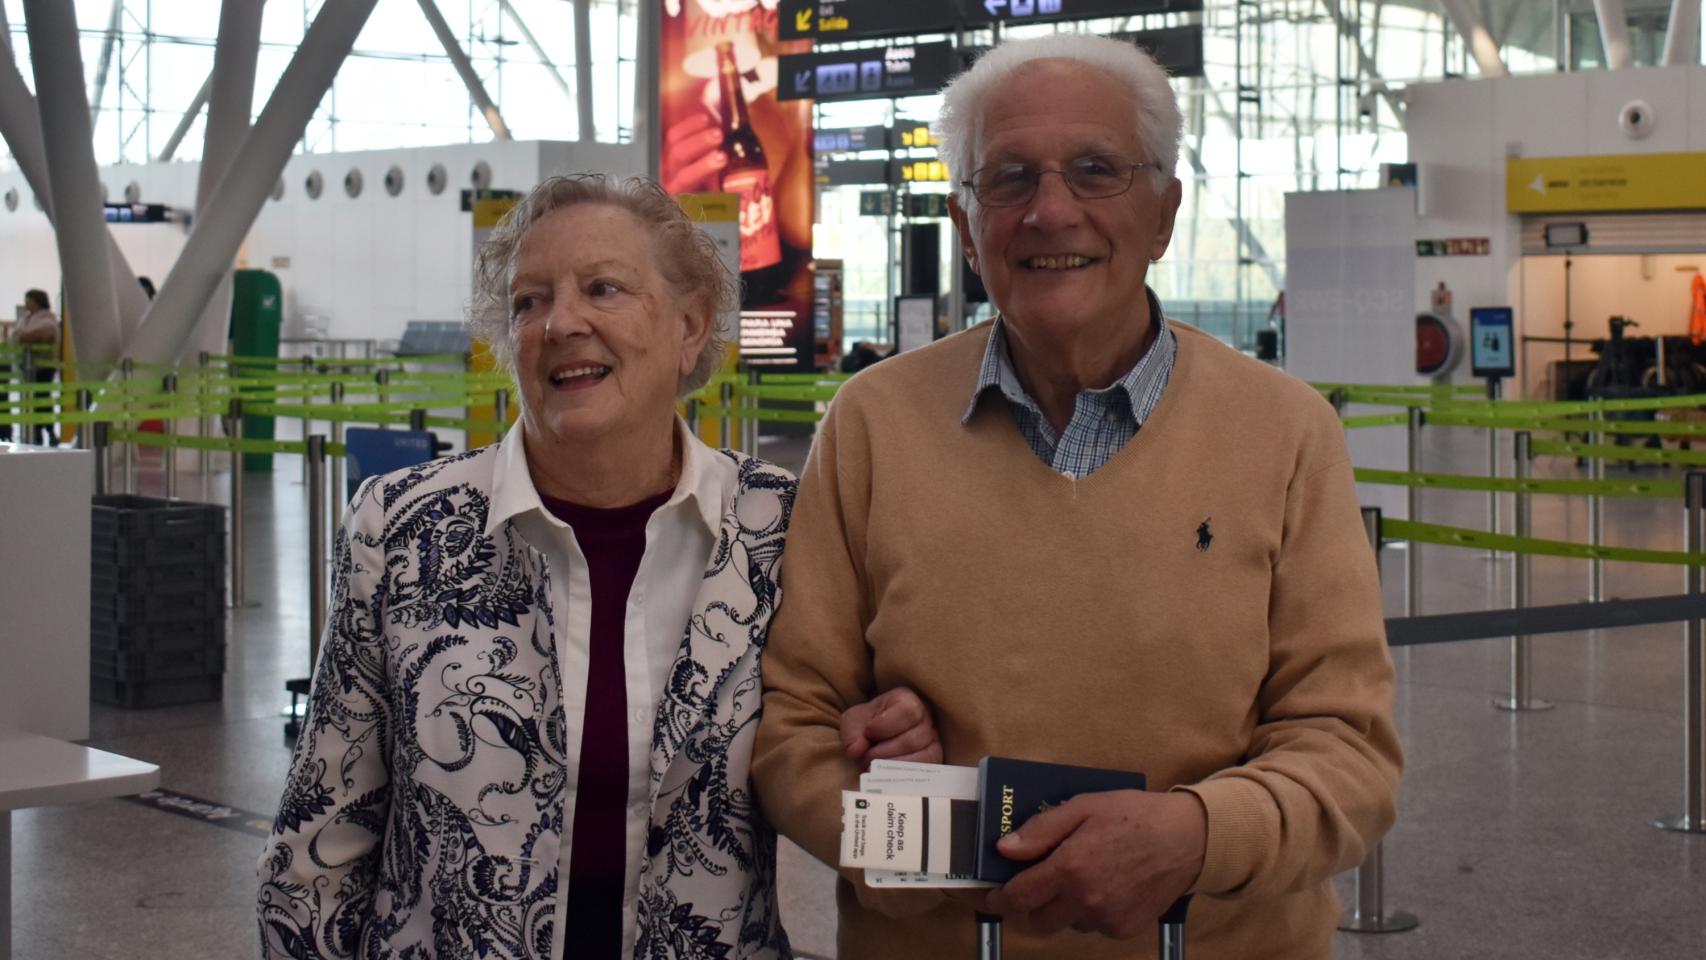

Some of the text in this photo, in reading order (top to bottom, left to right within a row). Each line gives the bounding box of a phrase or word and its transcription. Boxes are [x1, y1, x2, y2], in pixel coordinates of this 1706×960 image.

[686, 8, 778, 37] VINTAG
[818, 17, 848, 32] Salida
[1001, 785, 1014, 838] SPORT
[886, 802, 896, 861] claim check
[896, 812, 907, 851] Keep as
